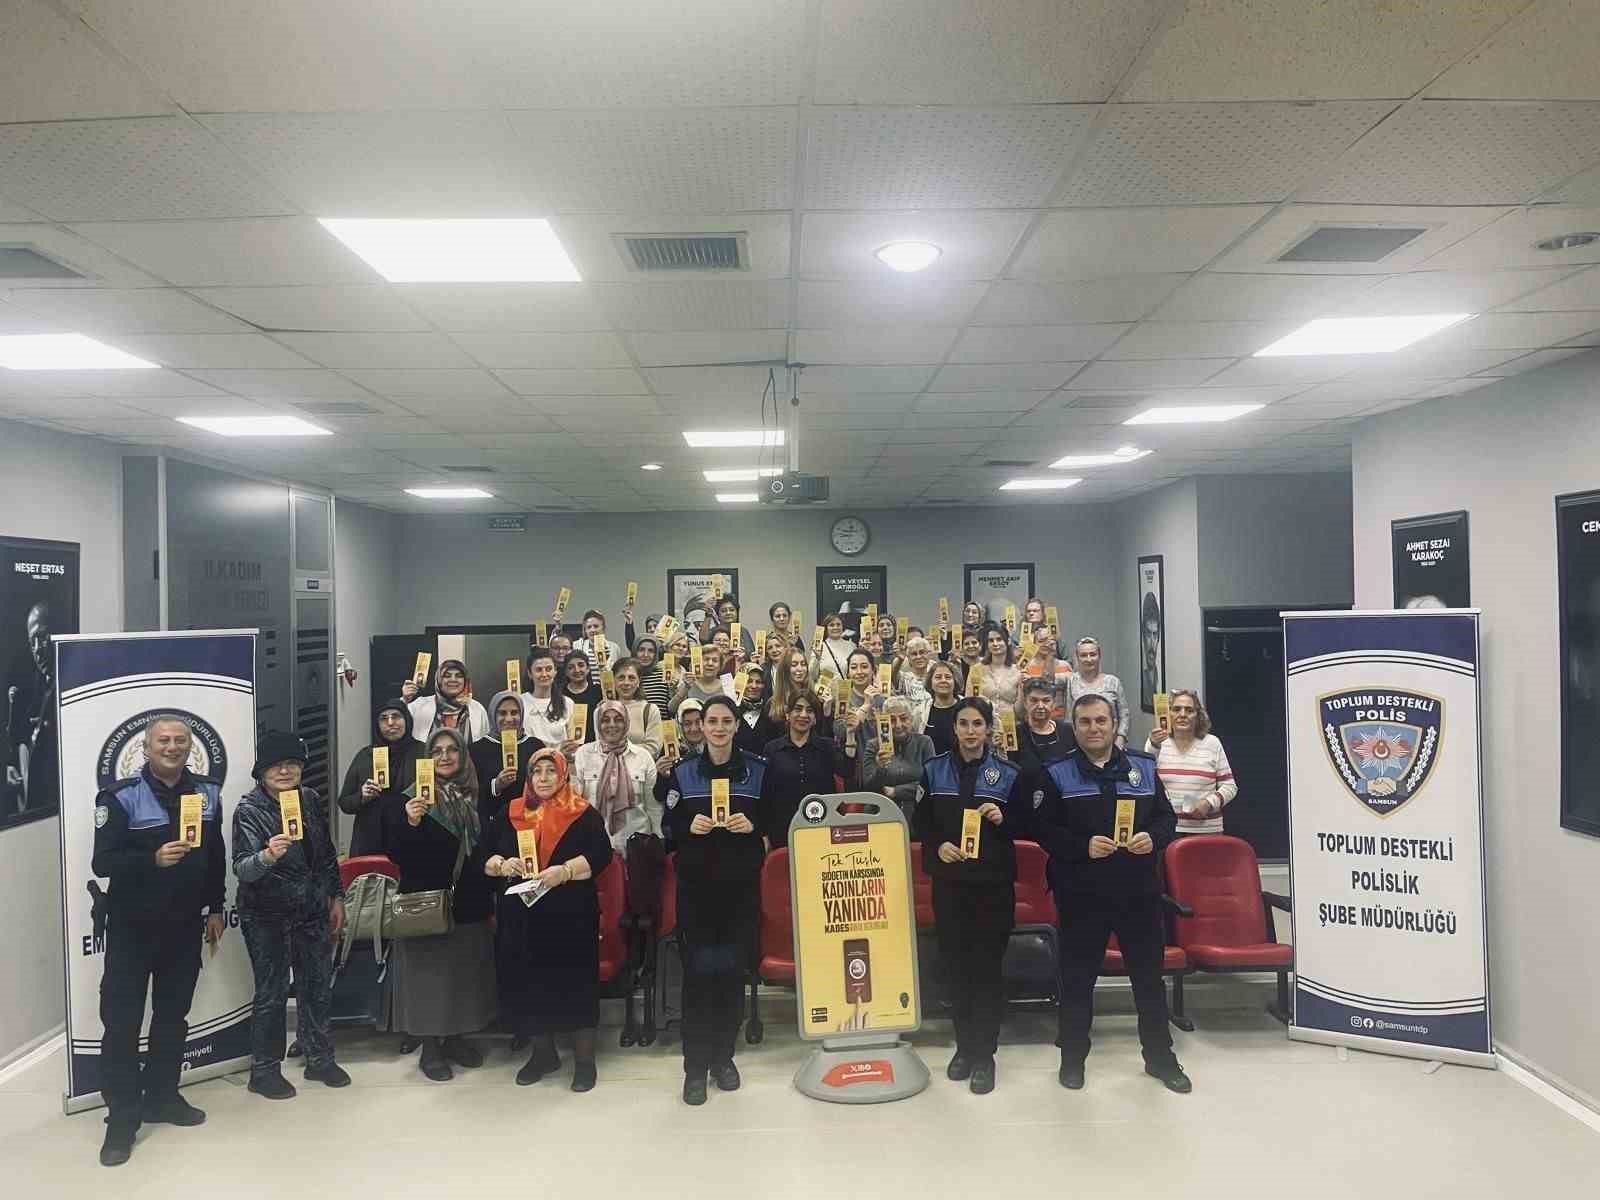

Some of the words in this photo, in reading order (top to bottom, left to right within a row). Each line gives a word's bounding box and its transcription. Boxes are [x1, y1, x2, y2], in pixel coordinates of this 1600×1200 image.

[1406, 541, 1429, 551] AHMET
[1411, 550, 1444, 561] KARAKOÇ
[1325, 695, 1373, 711] TOPLUM
[1377, 695, 1434, 712] DESTEKLİ
[1356, 708, 1407, 722] POLİS
[101, 729, 128, 776] SAMSUN
[1317, 832, 1376, 855] TOPLUM
[1380, 837, 1453, 861] DESTEKLİ
[822, 879, 886, 899] KADINLARIN
[1351, 868, 1419, 895] POLİSLİK
[823, 897, 887, 924] YANINDA
[1319, 902, 1357, 928] ŞUBE
[1361, 904, 1457, 934] MÜDÜRLÜĞÜ
